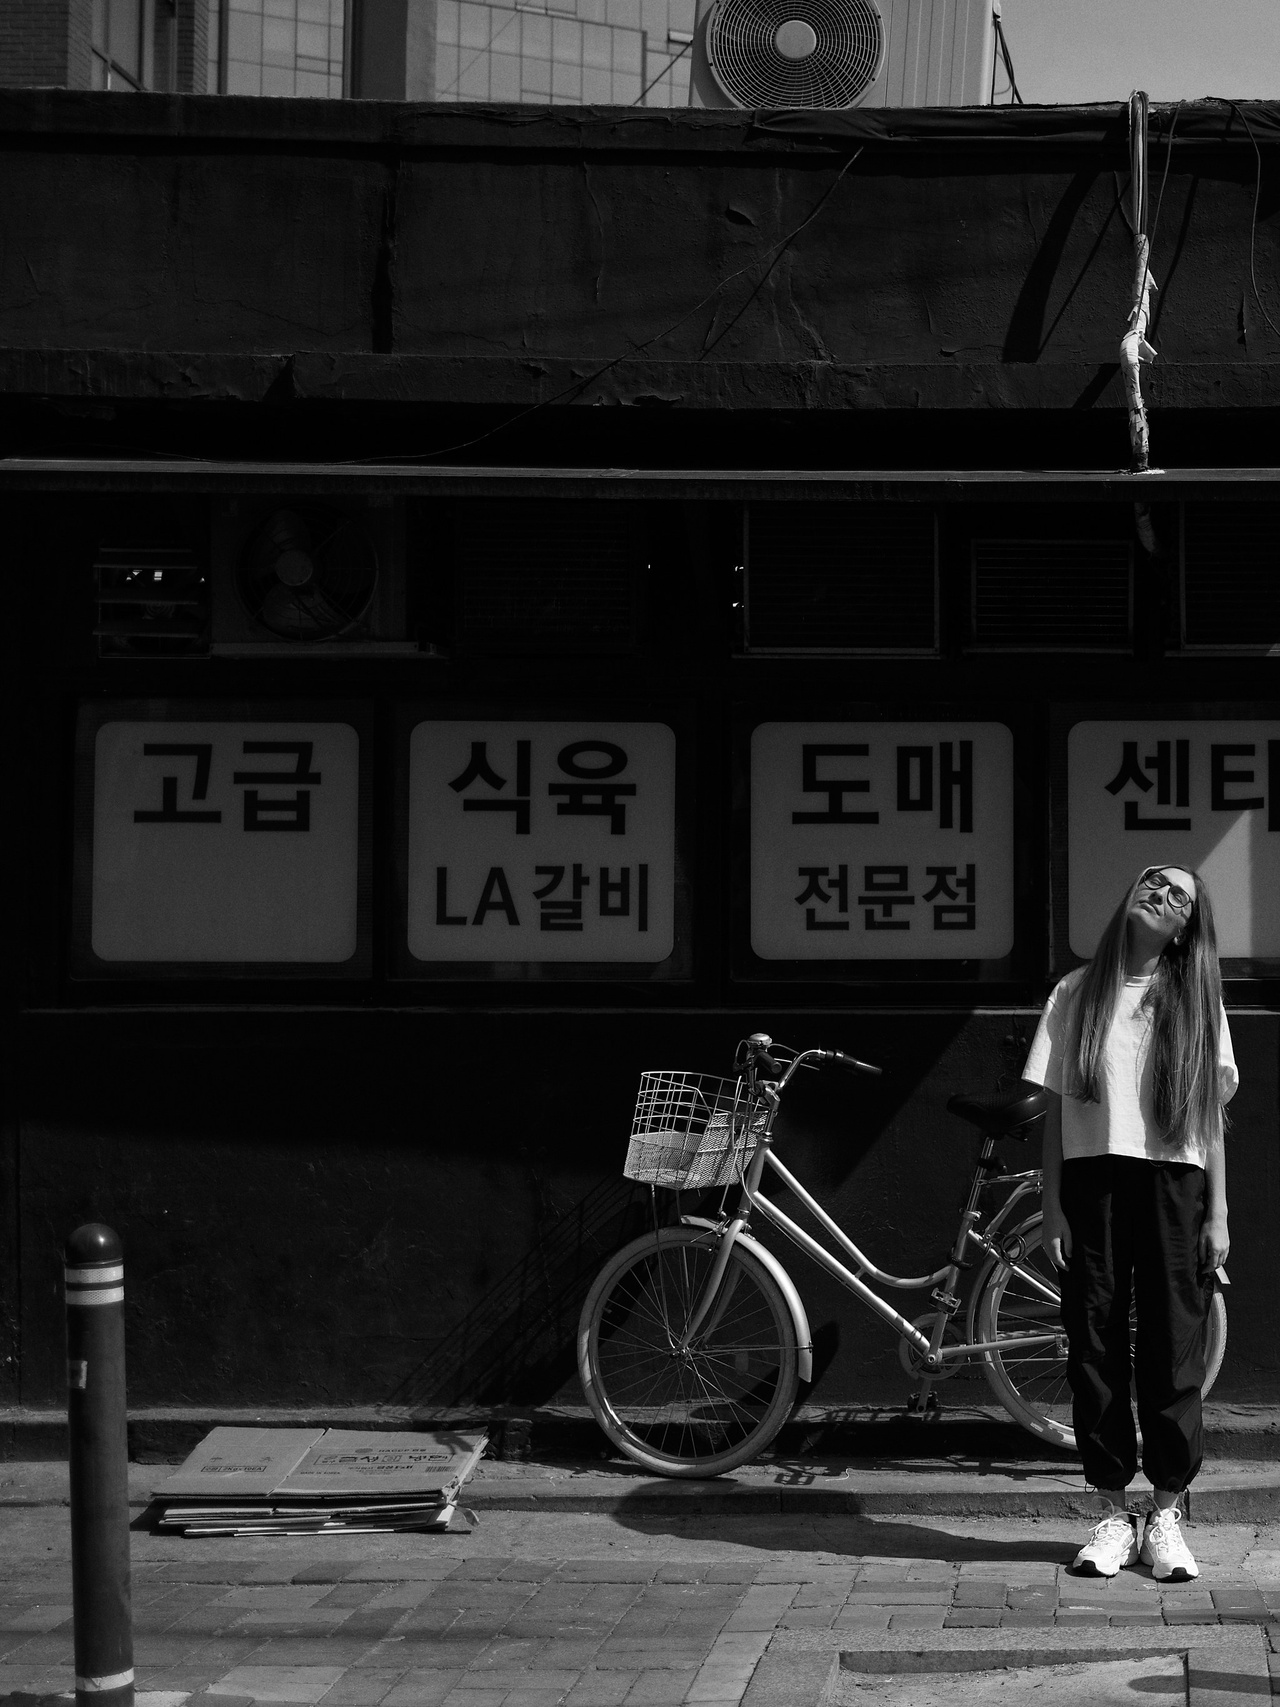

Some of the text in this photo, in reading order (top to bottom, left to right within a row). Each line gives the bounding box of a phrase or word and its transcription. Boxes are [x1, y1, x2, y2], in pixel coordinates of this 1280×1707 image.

[133, 741, 322, 831] 고급
[448, 740, 637, 835] 식육
[791, 740, 974, 833] 도매
[436, 863, 649, 931] LA갈비
[794, 862, 977, 931] 전문점
